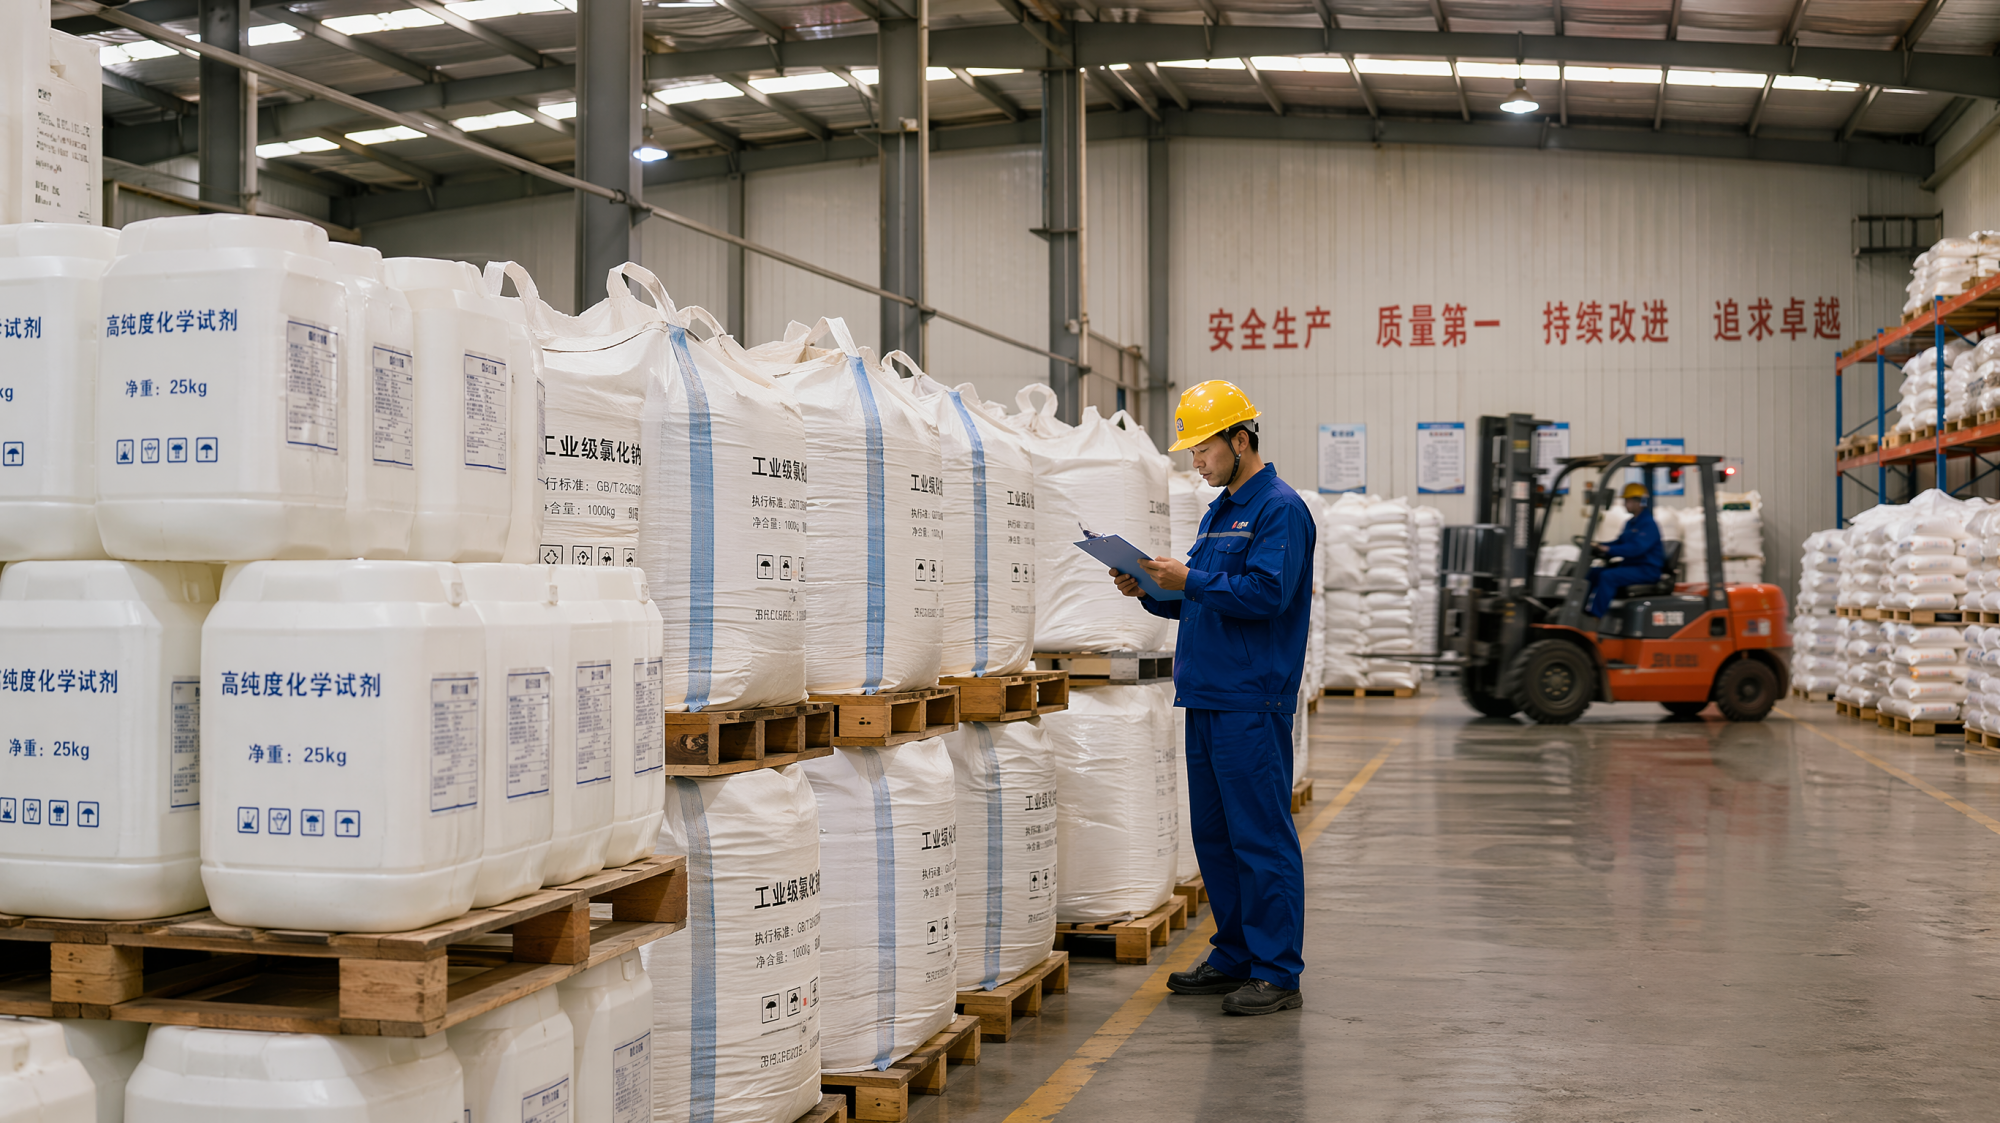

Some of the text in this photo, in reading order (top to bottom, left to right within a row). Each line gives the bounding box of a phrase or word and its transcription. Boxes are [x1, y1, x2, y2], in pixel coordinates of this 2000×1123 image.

[0, 316, 42, 339] 试剂
[106, 309, 238, 338] 高纯度化学试剂
[1208, 296, 1841, 351] 安全生产 质量第一 持续改进 追求卓越
[0, 668, 118, 693] 纯度化学试剂
[221, 671, 380, 697] 高纯度化学试剂
